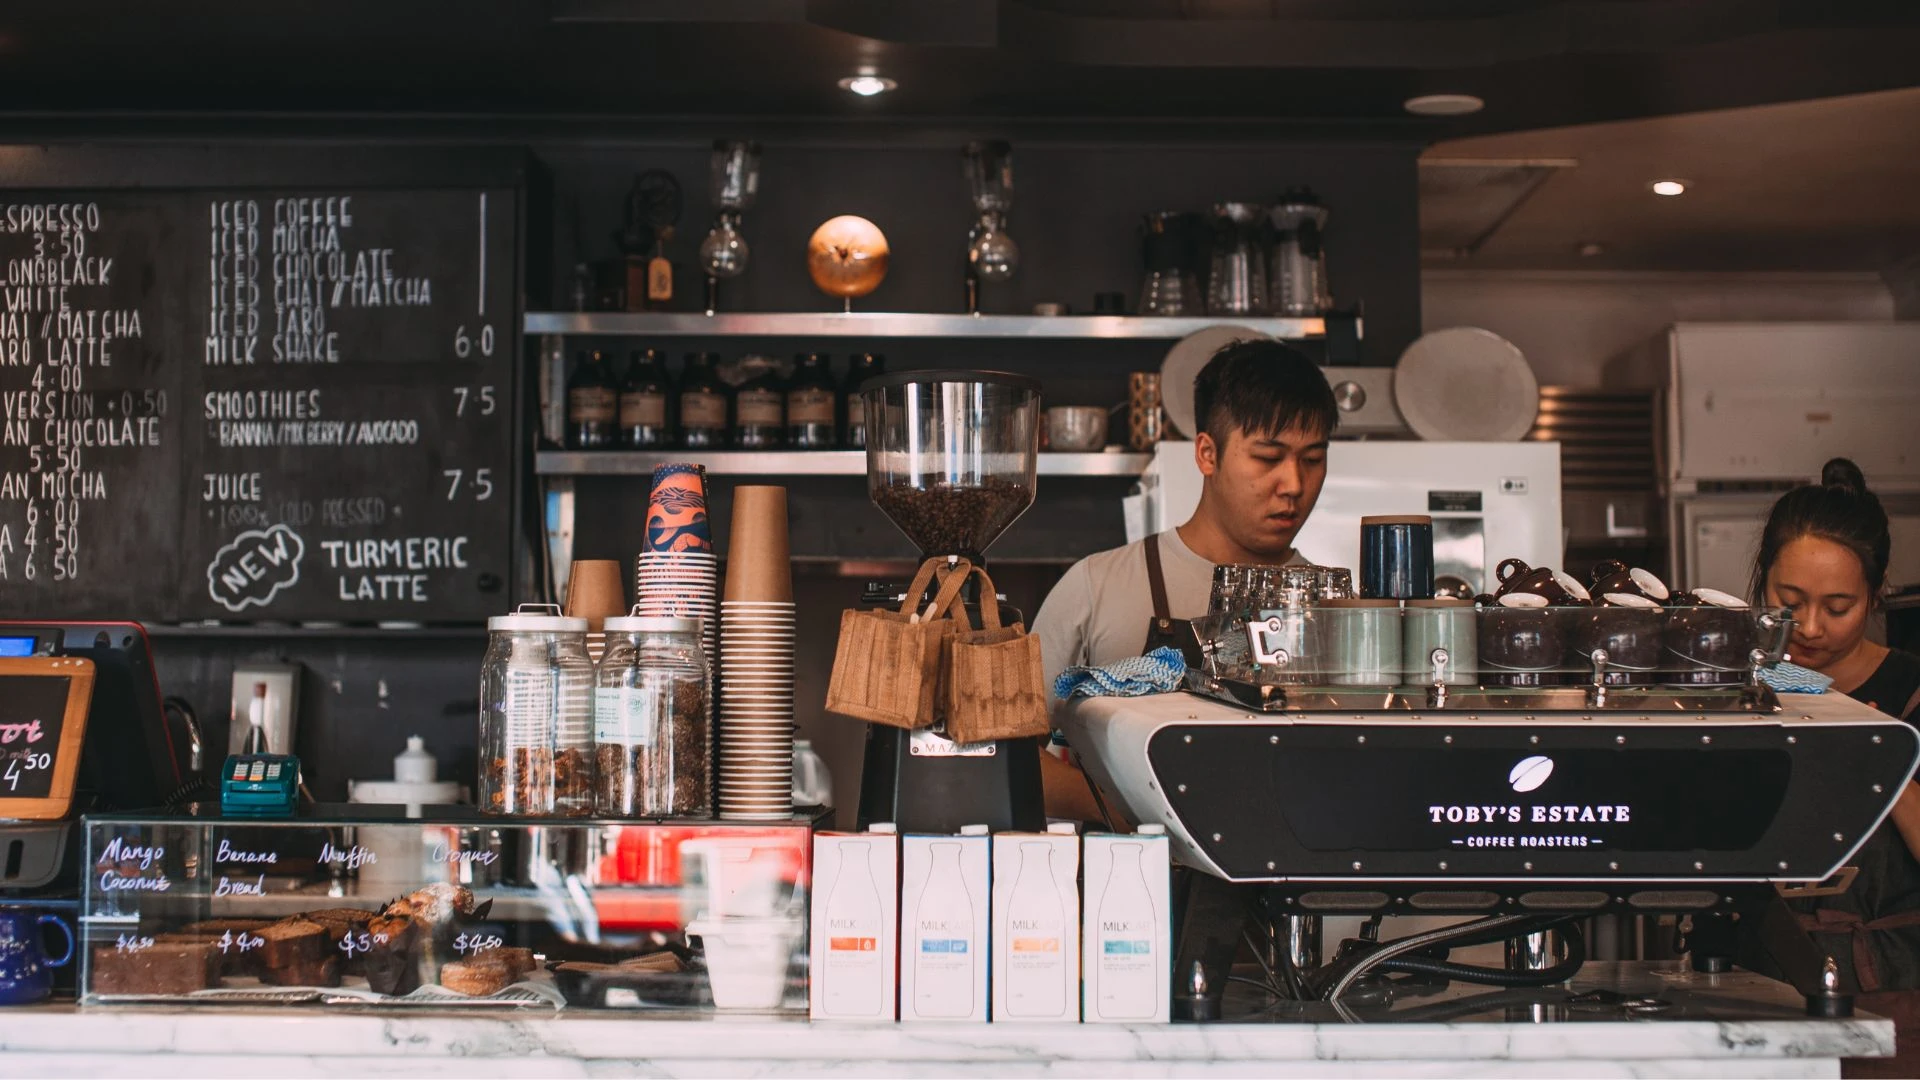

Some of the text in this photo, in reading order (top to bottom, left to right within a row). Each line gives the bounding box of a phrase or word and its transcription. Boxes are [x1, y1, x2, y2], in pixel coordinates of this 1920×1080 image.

[211, 197, 352, 229] ICED COFFEE
[211, 225, 340, 255] ICED MOCHA
[0, 257, 112, 286] ONGBLACK
[211, 248, 394, 282] ICED CHOCOLATE
[5, 286, 70, 312] WHITE
[211, 280, 260, 309] ICED
[210, 306, 324, 337] ICED TARO
[47, 337, 111, 367] LATTE
[206, 335, 258, 365] MILK
[272, 332, 339, 364] SHAKE
[4, 391, 94, 420] VERSION
[205, 389, 320, 420] SMOOTHIES
[4, 417, 160, 446] AN CHOCOLATE
[41, 471, 106, 500] MOCHA
[203, 473, 261, 501] JUICE
[219, 531, 289, 594] NEW
[320, 537, 468, 569] TURMERIC
[339, 574, 428, 601] LATTE
[1429, 805, 1631, 823] TOBY'S ESTATE
[100, 836, 165, 869] Mango
[215, 839, 280, 863] Banana
[317, 842, 378, 870] Muffin
[432, 845, 500, 866] Cronut
[1467, 836, 1588, 847] COFFEE ROASTERS
[100, 869, 172, 892] Coconut
[215, 874, 266, 897] Bread
